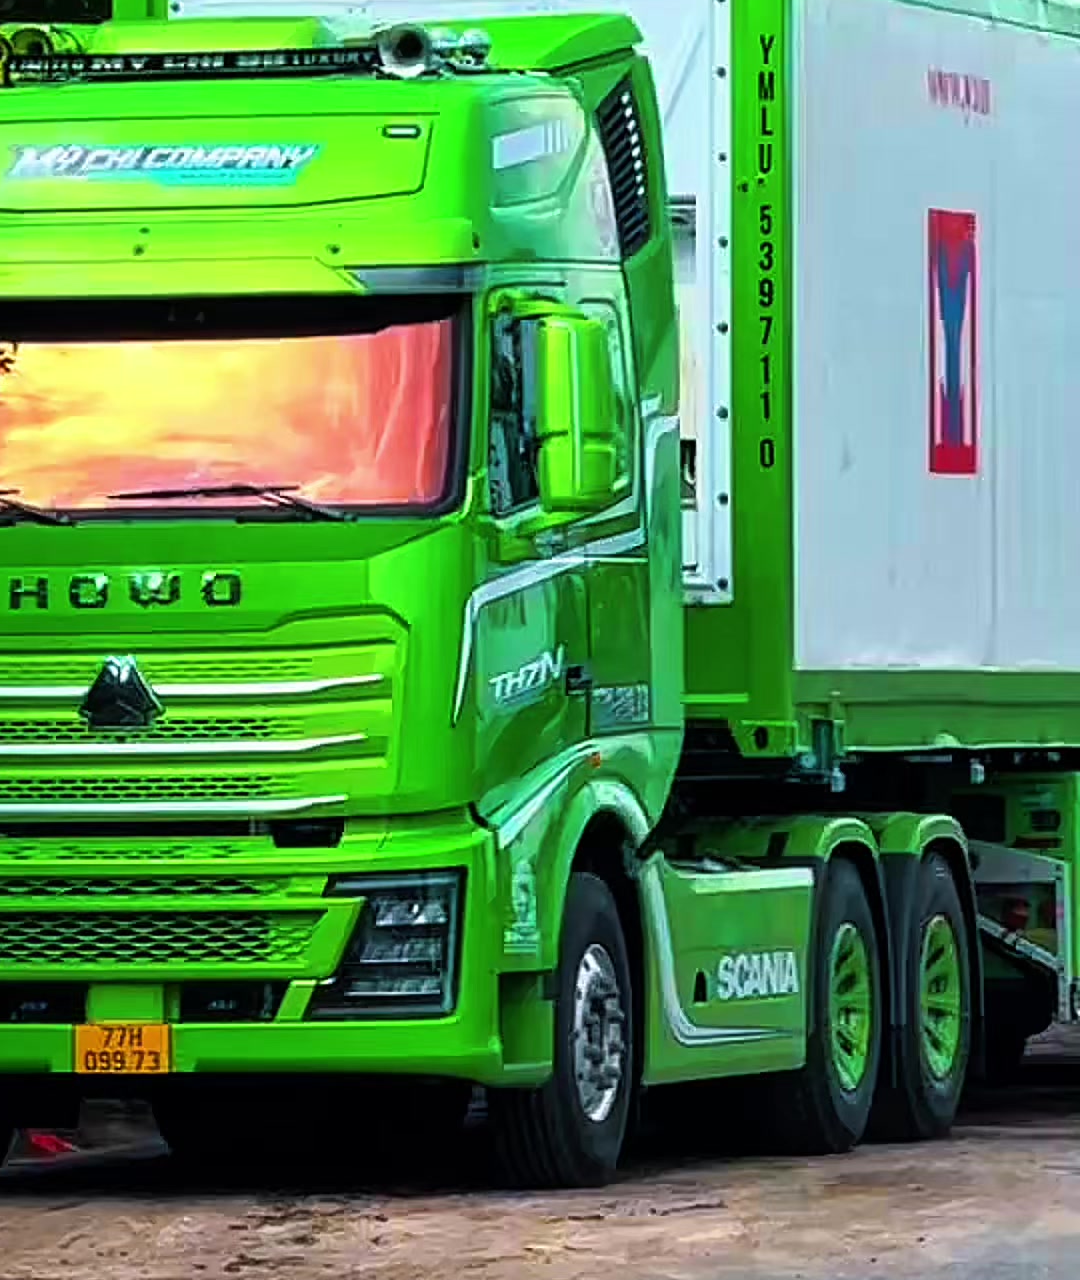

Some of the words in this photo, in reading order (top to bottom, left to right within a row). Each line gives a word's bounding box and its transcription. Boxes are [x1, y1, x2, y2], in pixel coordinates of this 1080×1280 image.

[757, 33, 776, 175] YMLU
[8, 571, 241, 610] HOWO
[717, 950, 799, 1000] SCANIA
[101, 1026, 143, 1049] 77H
